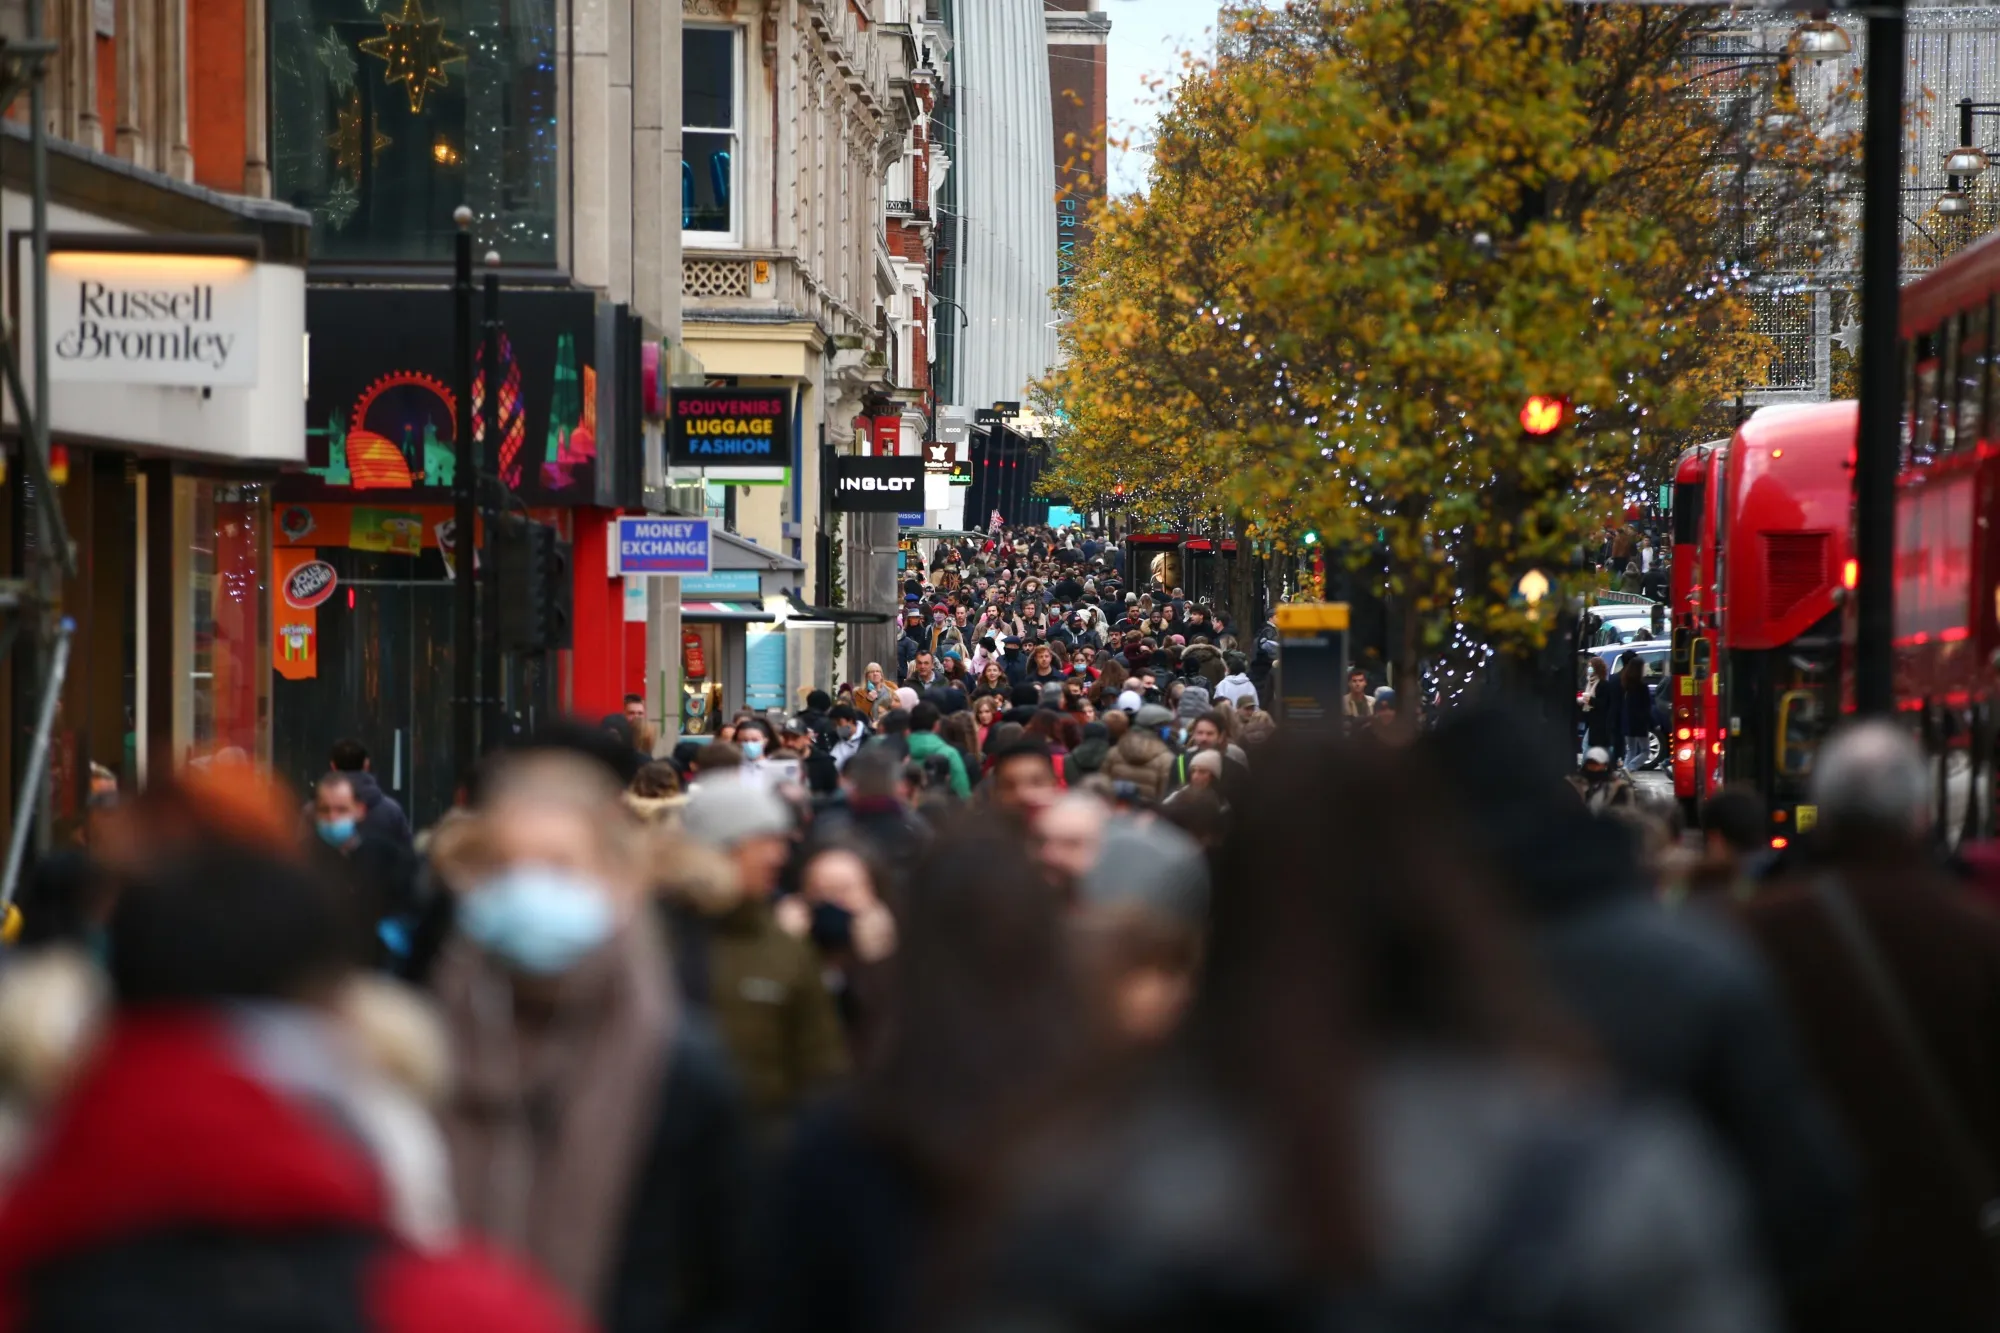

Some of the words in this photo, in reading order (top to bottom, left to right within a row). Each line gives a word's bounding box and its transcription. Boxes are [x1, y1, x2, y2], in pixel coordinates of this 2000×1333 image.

[79, 281, 212, 321] Russell
[678, 400, 782, 415] SOUVENIRS
[686, 419, 773, 434] LUGGAGE
[689, 439, 771, 453] FASHION
[840, 477, 916, 491] INGLOT
[635, 523, 694, 537] MONEY
[621, 541, 706, 555] EXCHANGE
